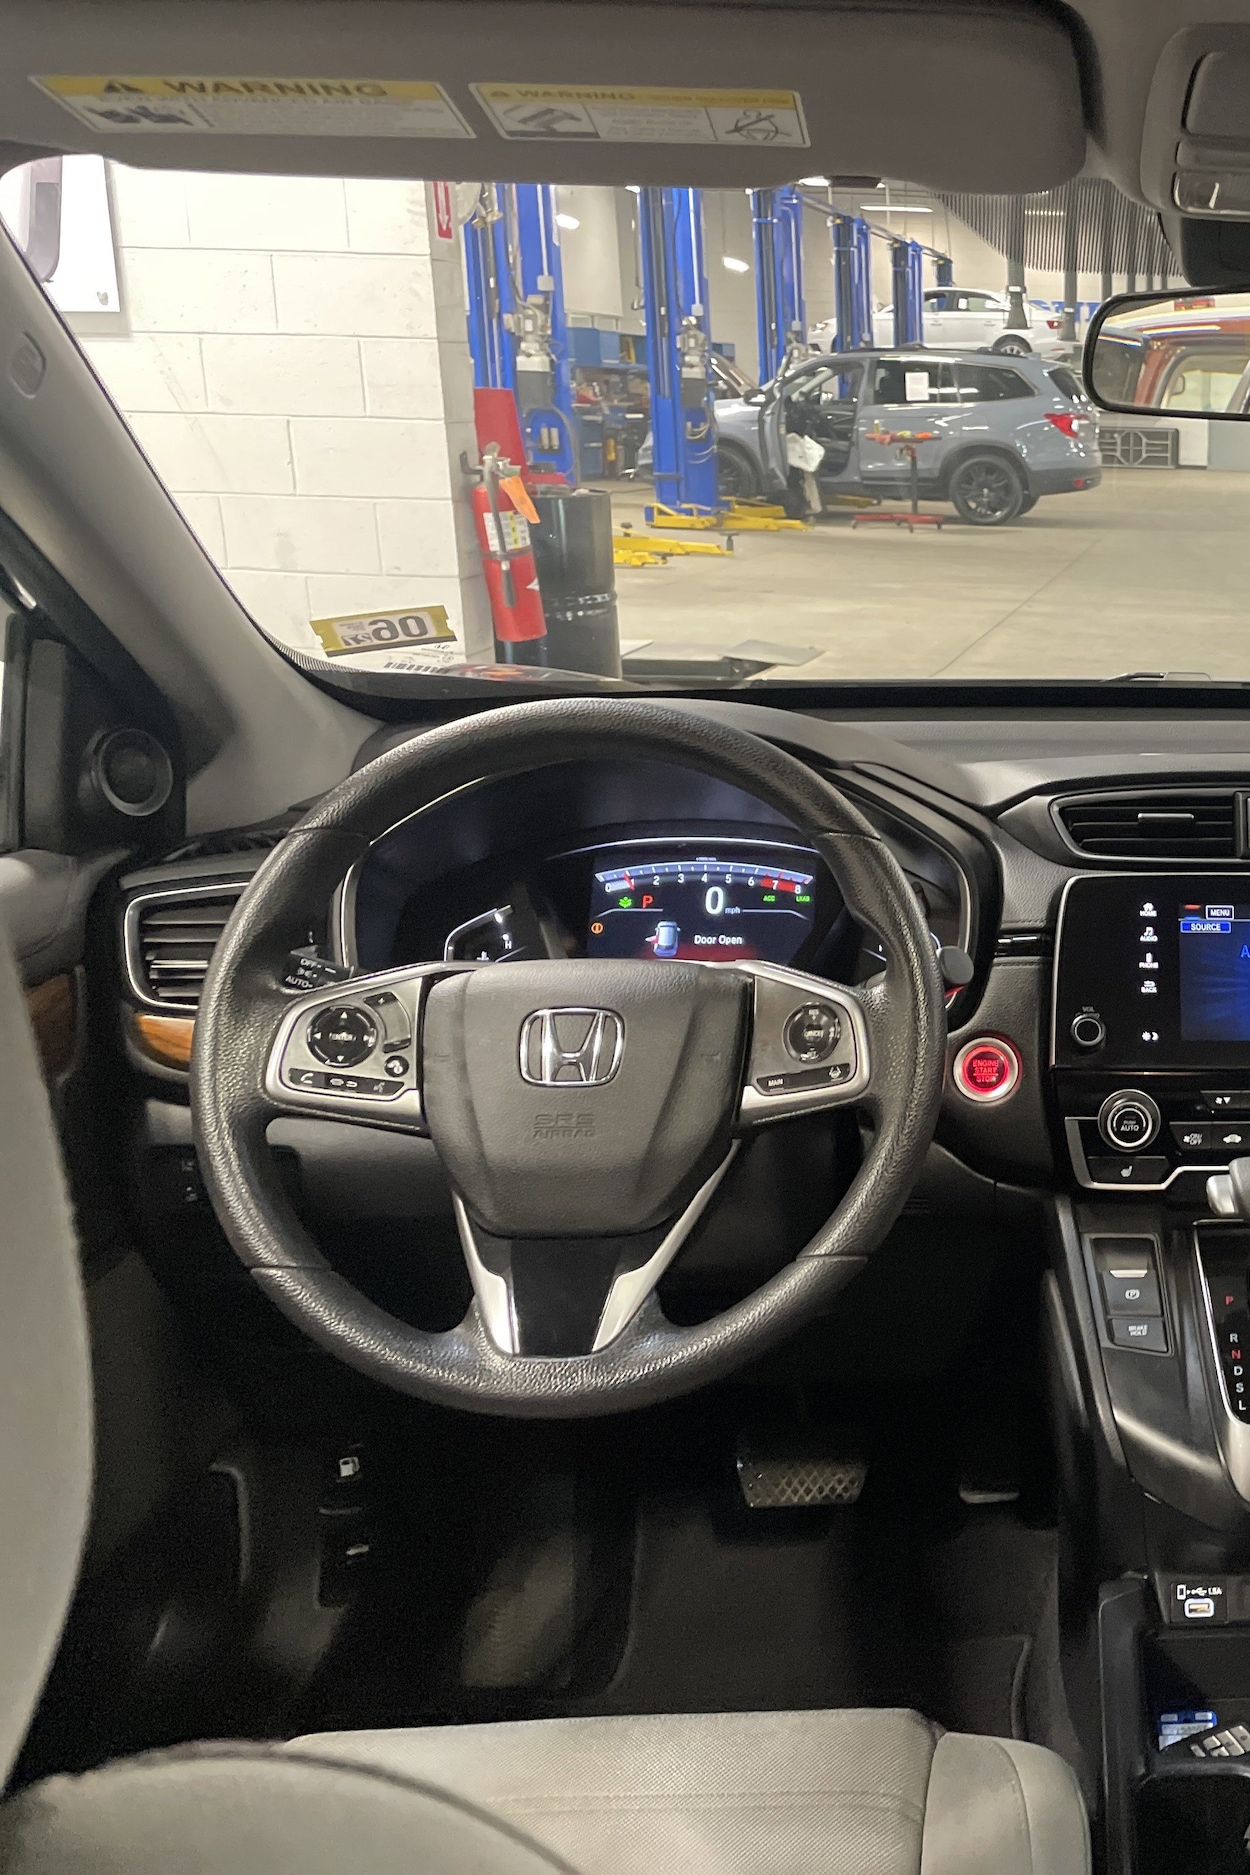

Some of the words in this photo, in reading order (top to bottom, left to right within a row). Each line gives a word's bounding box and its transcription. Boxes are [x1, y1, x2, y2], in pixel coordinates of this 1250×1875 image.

[163, 80, 388, 98] WARNING
[517, 89, 637, 101] WARNING
[652, 876, 660, 886] 2
[677, 873, 684, 883] 3
[701, 873, 708, 883] 4
[725, 874, 732, 884] 5
[748, 877, 755, 886] 6
[772, 880, 779, 890] 7
[794, 884, 802, 894] 8
[642, 895, 653, 909] P
[705, 886, 724, 915] 0
[725, 906, 741, 915] mph
[1210, 908, 1230, 917] MENU
[1190, 922, 1221, 932] SOURCE
[504, 940, 512, 950] H
[694, 934, 717, 945] Door
[718, 934, 743, 947] Open
[300, 957, 318, 969] OFF
[285, 975, 310, 989] AUTO
[1081, 1005, 1095, 1013] VOL
[972, 1059, 998, 1067] ENGINE
[767, 1078, 784, 1087] MAIN
[1120, 1124, 1140, 1132] AUTO
[1225, 1296, 1234, 1305] P
[1229, 1333, 1239, 1343] R
[1231, 1349, 1241, 1360] N
[1233, 1366, 1243, 1377] D
[1235, 1382, 1244, 1393] S
[1238, 1400, 1247, 1411] L
